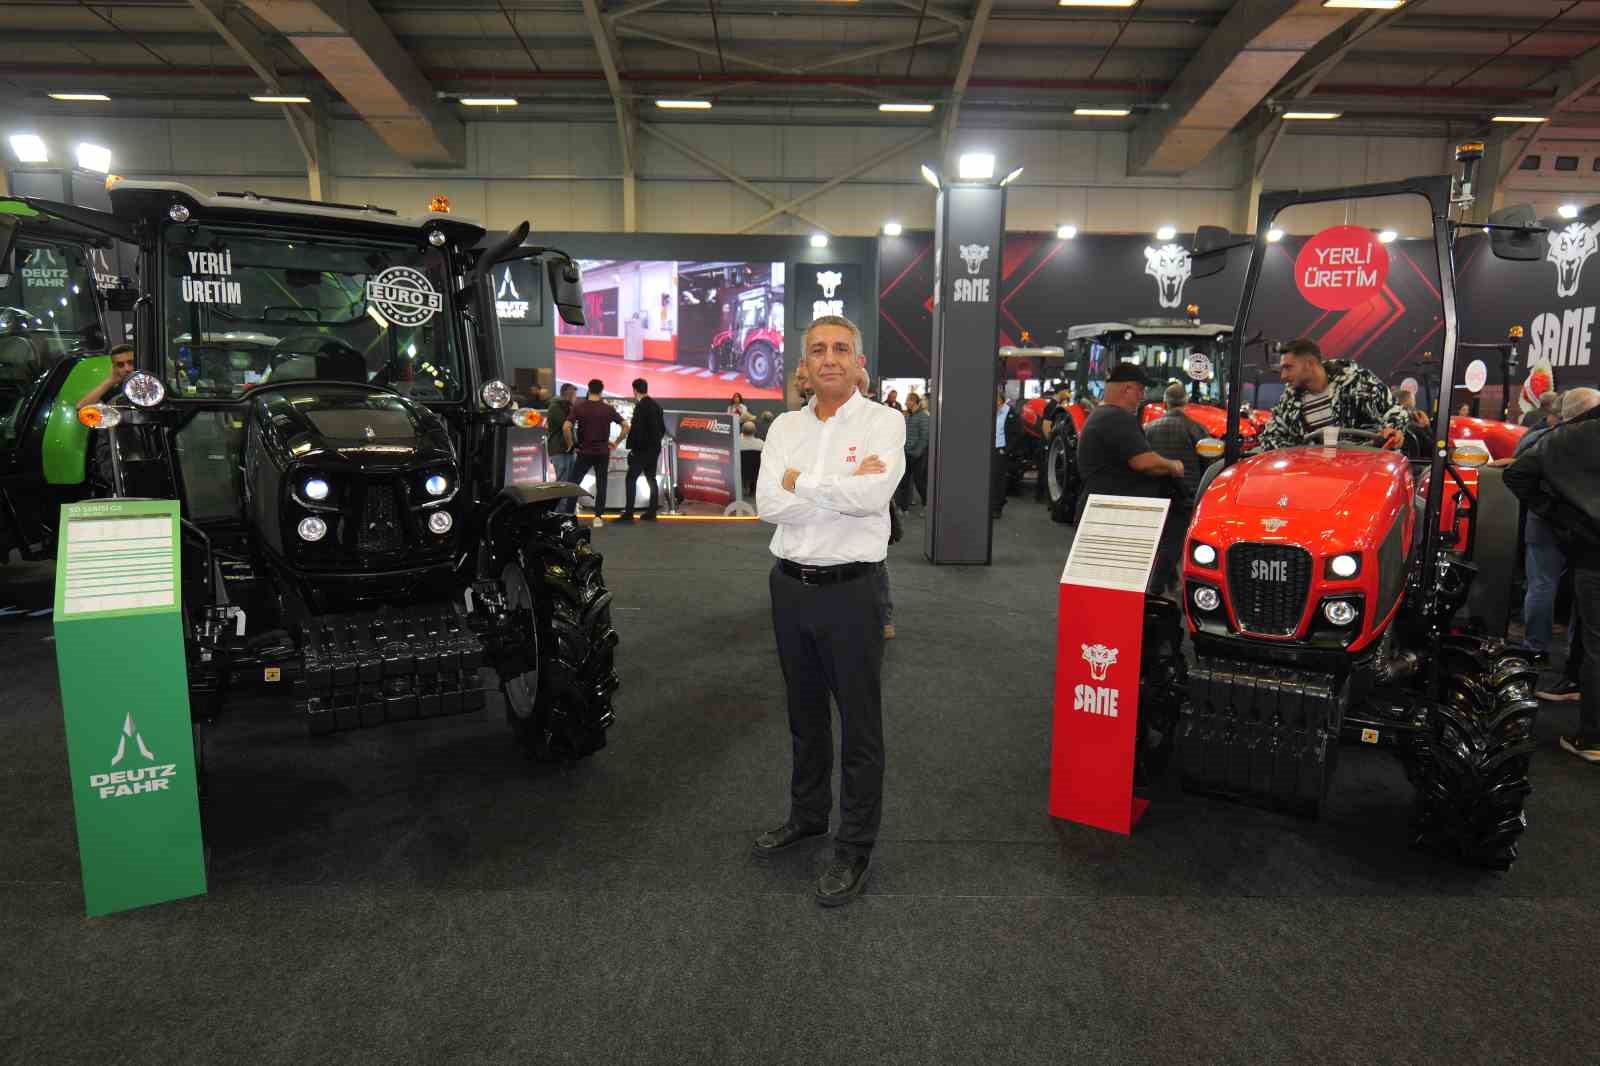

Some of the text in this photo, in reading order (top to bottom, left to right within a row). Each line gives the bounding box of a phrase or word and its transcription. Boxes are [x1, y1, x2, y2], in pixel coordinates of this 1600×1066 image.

[187, 248, 232, 275] YERLİ
[1314, 242, 1372, 265] YERLİ
[22, 268, 68, 279] DEUTZ
[27, 279, 65, 288] FAHR
[1304, 265, 1377, 287] ÜRETİM
[182, 275, 241, 304] ÜRETİM
[372, 285, 439, 308] EURO 5
[954, 278, 990, 302] SAME
[1527, 306, 1596, 368] SAME
[1251, 559, 1288, 581] SAME
[1074, 683, 1120, 718] SAME
[90, 764, 176, 787] DEUTZ
[100, 778, 169, 799] FAHR
